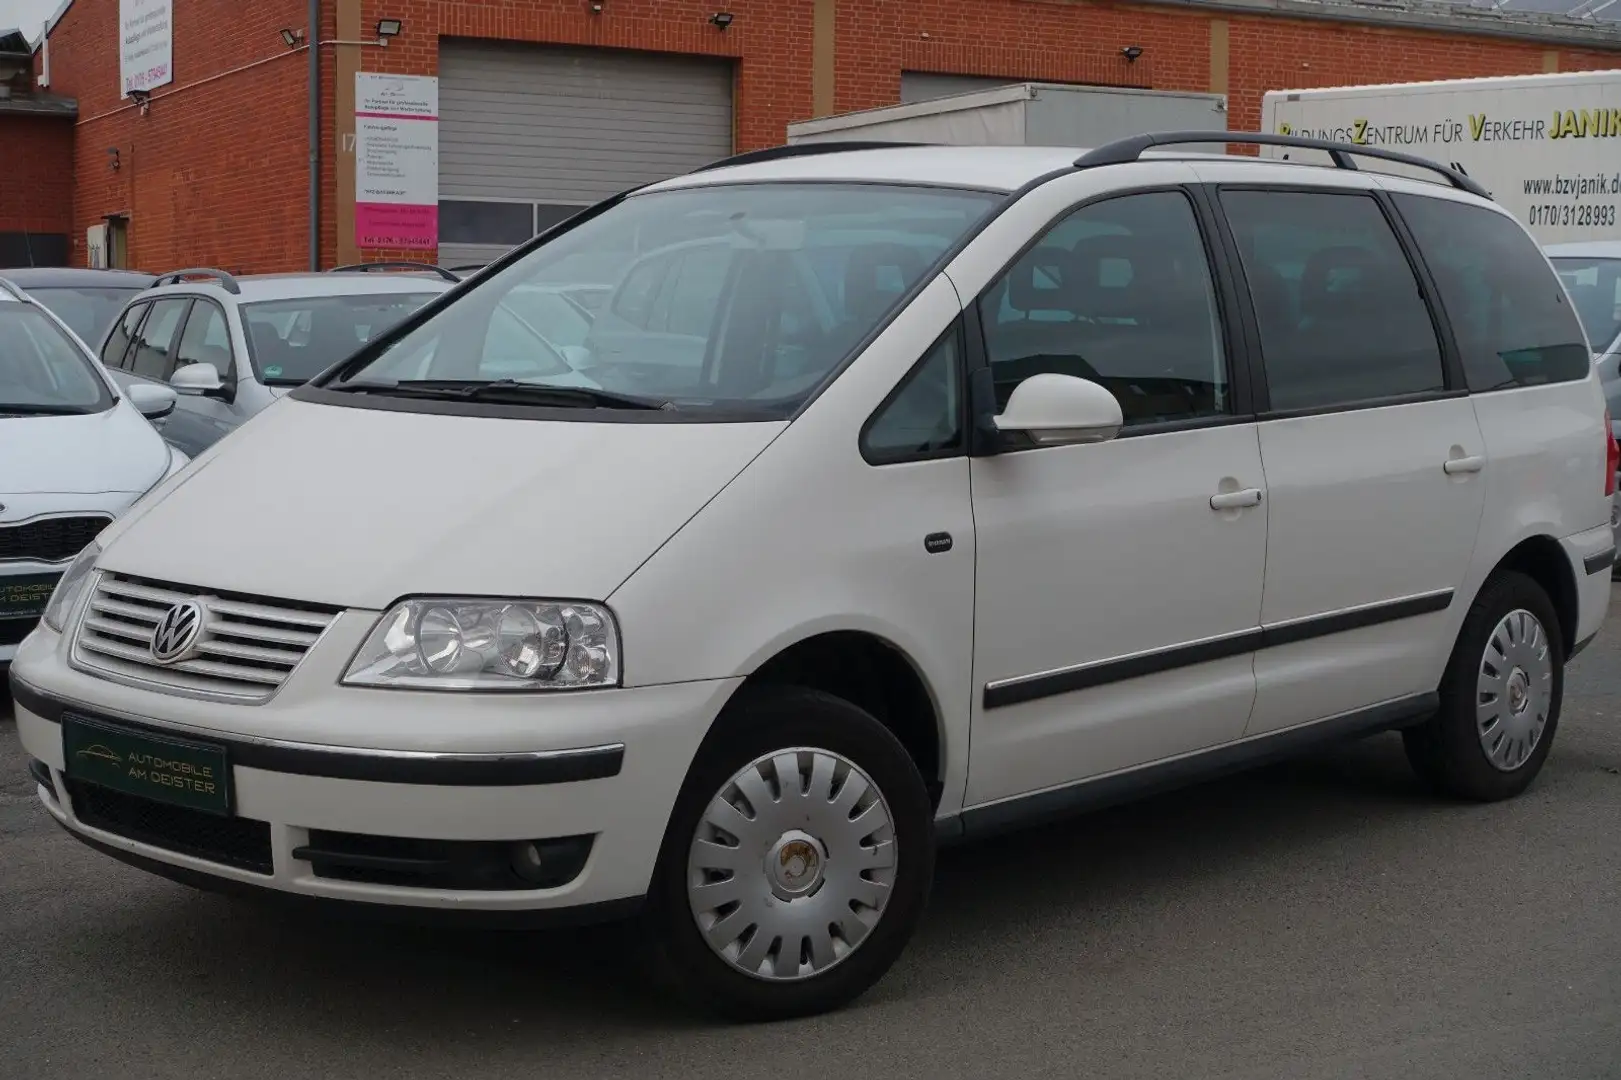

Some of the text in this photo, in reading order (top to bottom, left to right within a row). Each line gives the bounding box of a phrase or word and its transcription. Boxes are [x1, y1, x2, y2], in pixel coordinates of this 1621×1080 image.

[1434, 119, 1463, 143] FÜR
[1468, 114, 1545, 141] VERKEHR
[342, 133, 356, 152] 17
[1529, 205, 1615, 226] 0170/3128993
[129, 752, 213, 778] AUTOMOBILE
[128, 767, 216, 795] AM DEISTER
